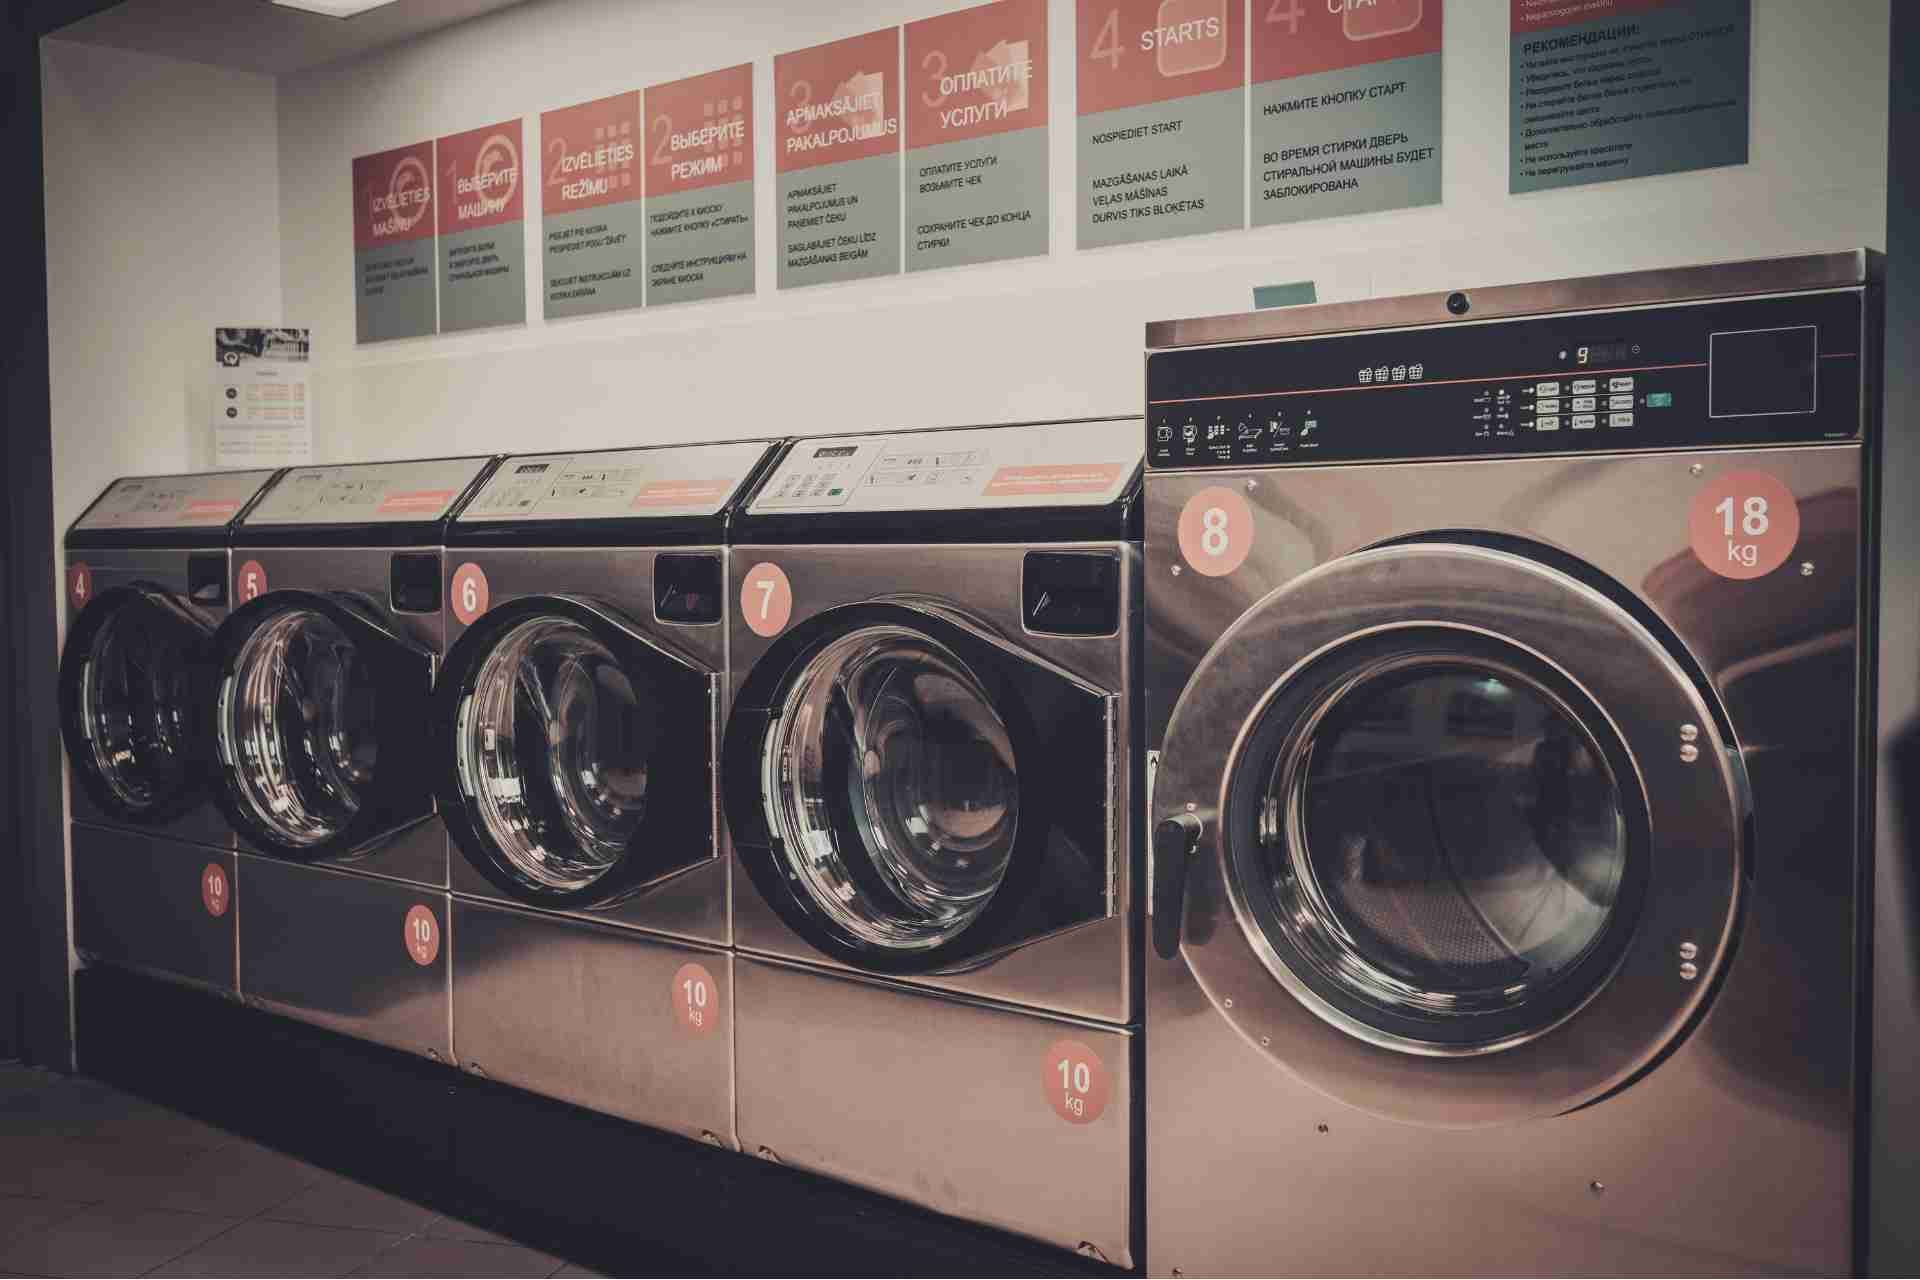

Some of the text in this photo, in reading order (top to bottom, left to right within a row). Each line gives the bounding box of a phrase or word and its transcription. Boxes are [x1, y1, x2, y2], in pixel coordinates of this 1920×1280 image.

[1140, 16, 1220, 51] STARTS
[940, 60, 1033, 95] ОПЛАТИТЕ
[786, 92, 881, 126] APMAKSĀJIET
[940, 99, 1008, 129] УСЛУГИ
[1264, 81, 1408, 116] НАЖМИТЕ КНОПКУ СТАРТ
[671, 120, 745, 151] ВЫБЕРИТЕ
[787, 118, 897, 152] PAKALPOJUMUS
[1092, 120, 1184, 144] NOSPIEDIET START
[1264, 132, 1409, 164] ВО ВРЕМЯ СТИРКИ ДВЕРЬ
[671, 156, 722, 181] РЕЖИМ
[1264, 147, 1435, 182] СТИРАЛЬНОЙ МАШИНЫ БУДЕТ
[1264, 178, 1359, 201] ЗАБЛОКИРОВАНА
[1092, 209, 1127, 223] DURVIS
[1129, 206, 1151, 217] TIKS
[1203, 507, 1229, 556] 8
[1715, 496, 1768, 536] 18
[1727, 539, 1757, 567] kg
[75, 573, 86, 599] 4
[246, 572, 258, 600] 5
[462, 576, 477, 612] 6
[756, 579, 776, 620] 7
[208, 875, 222, 897] 10
[413, 918, 431, 942] 10
[683, 979, 706, 1007] 10
[1057, 1059, 1090, 1094] 10
[1065, 1091, 1083, 1117] kg
